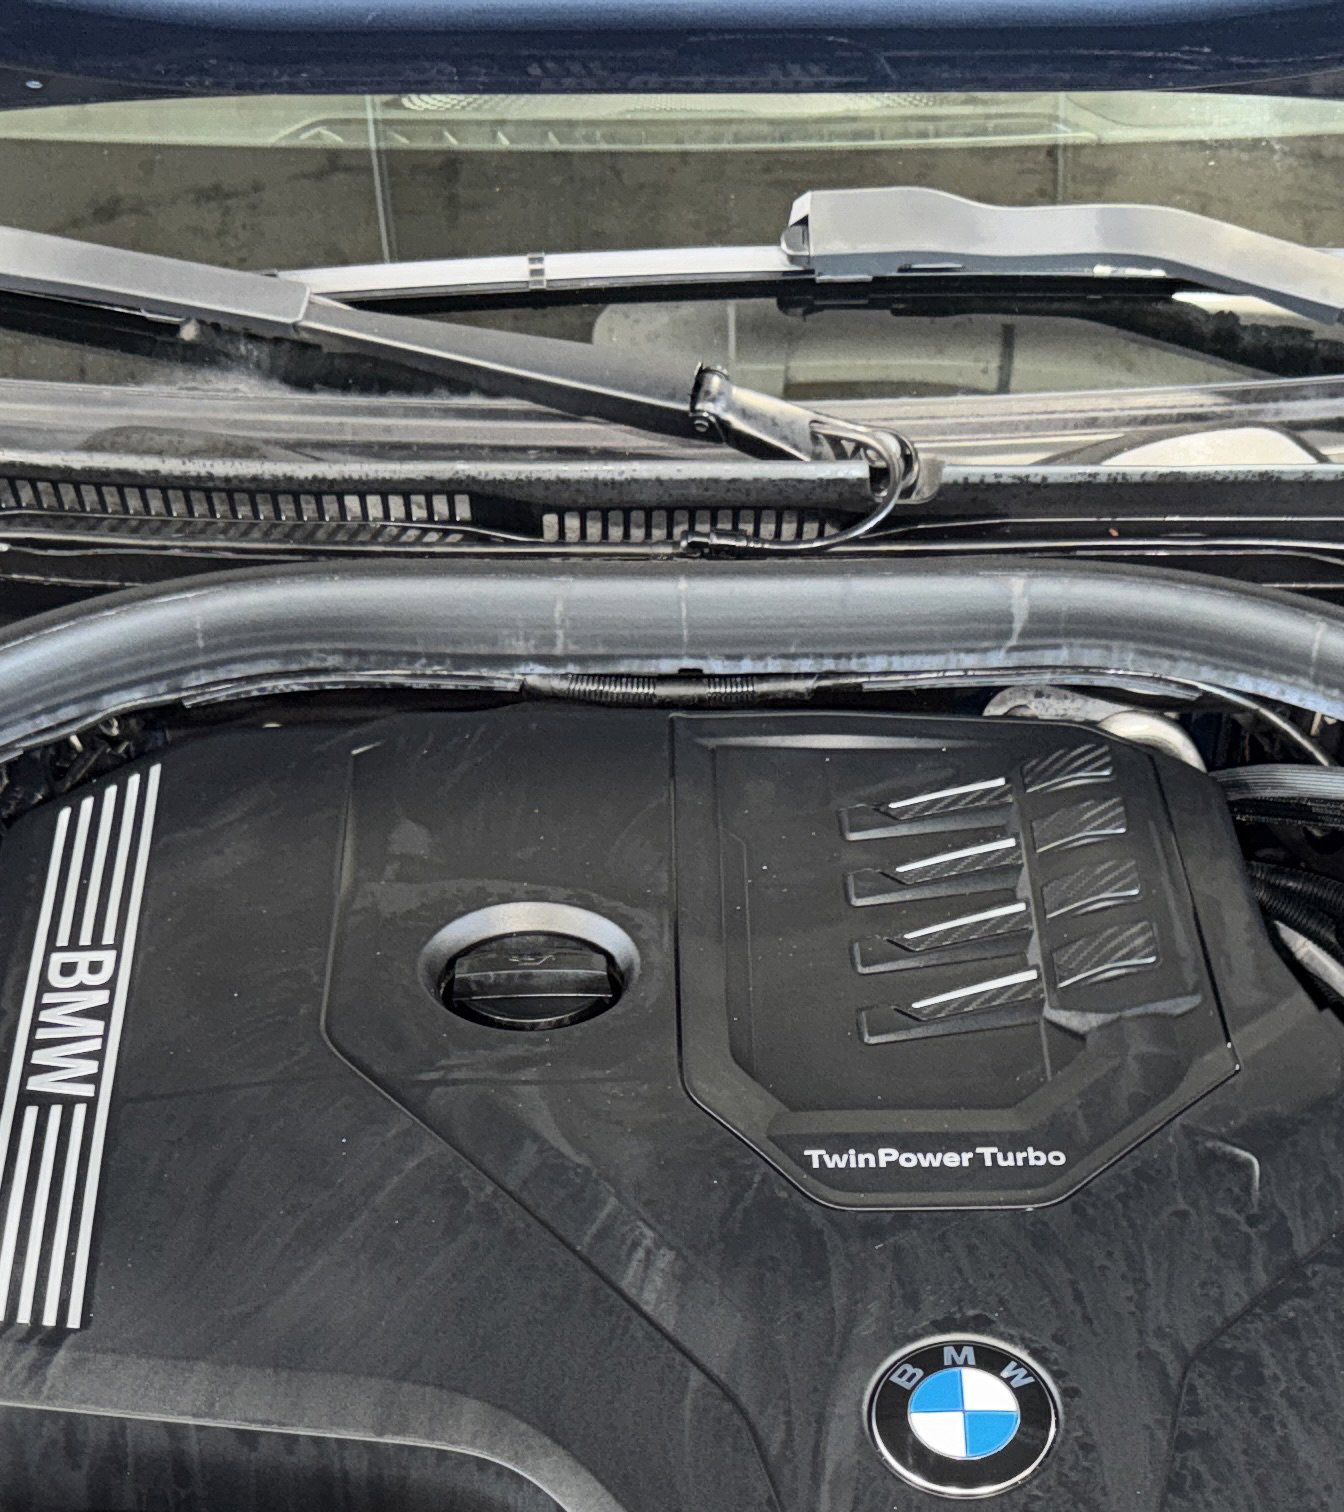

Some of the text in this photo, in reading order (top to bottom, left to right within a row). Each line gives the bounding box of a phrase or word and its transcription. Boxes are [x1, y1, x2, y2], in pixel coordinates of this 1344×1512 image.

[26, 950, 117, 1097] BMW
[804, 1147, 1066, 1168] TwinPower Turbo
[889, 1346, 1035, 1390] BMW
